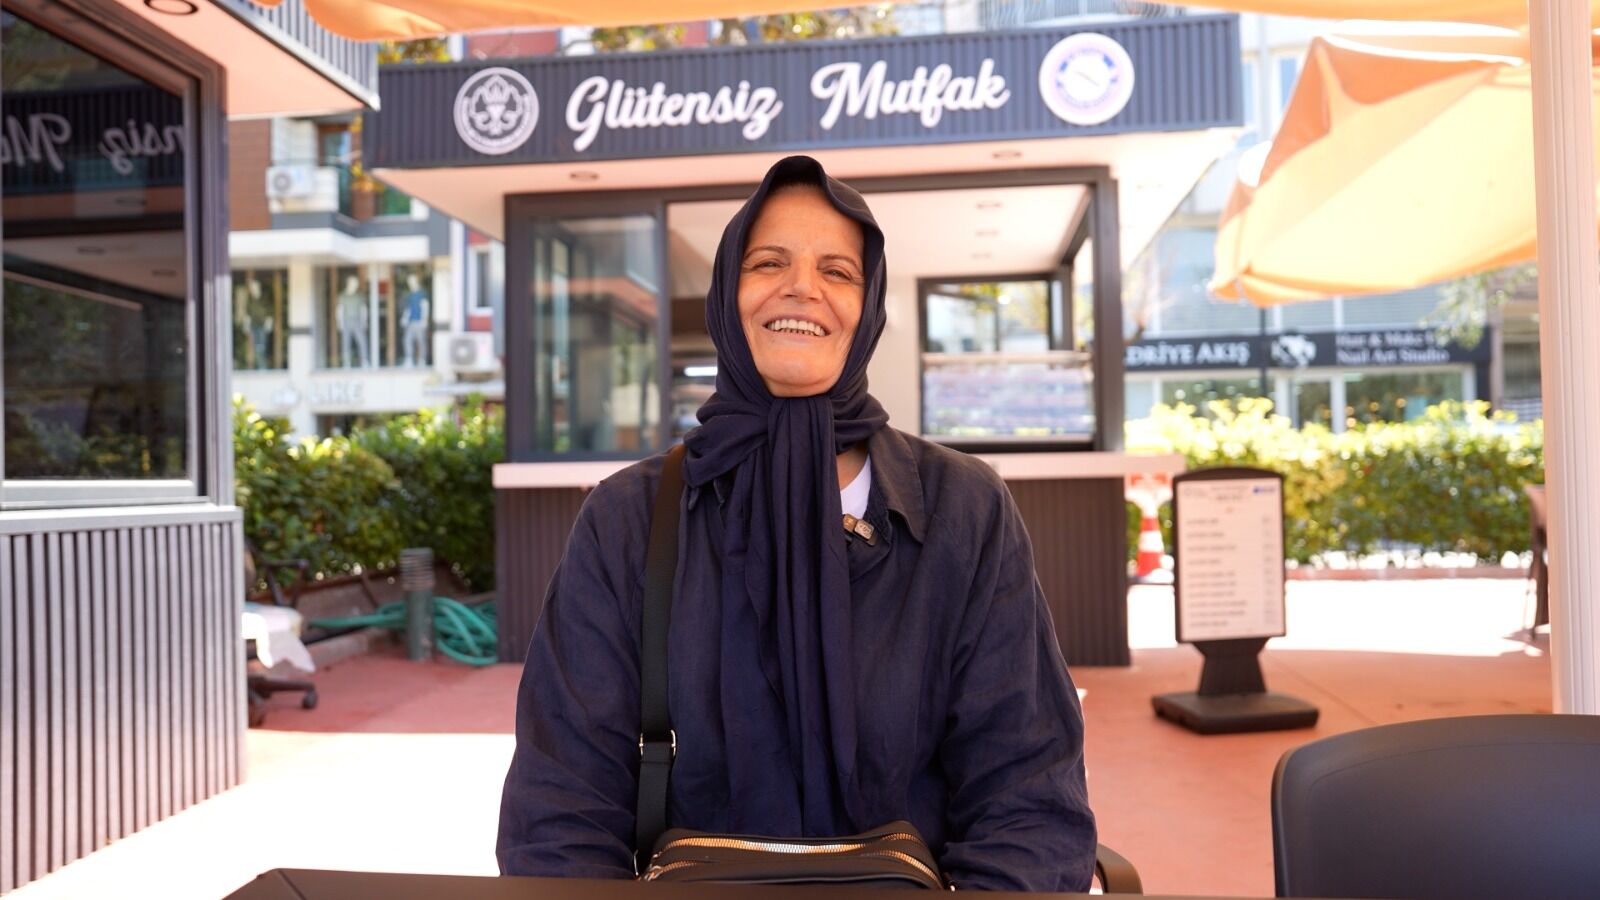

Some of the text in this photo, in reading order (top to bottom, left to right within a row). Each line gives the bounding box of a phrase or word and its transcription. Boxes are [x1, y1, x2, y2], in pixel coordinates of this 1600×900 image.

[565, 76, 783, 152] Glütensiz
[811, 58, 1010, 128] Mutfak
[1124, 341, 1250, 366] DRİYE AKIŞ
[1372, 349, 1397, 363] Art
[1399, 347, 1450, 363] Studio
